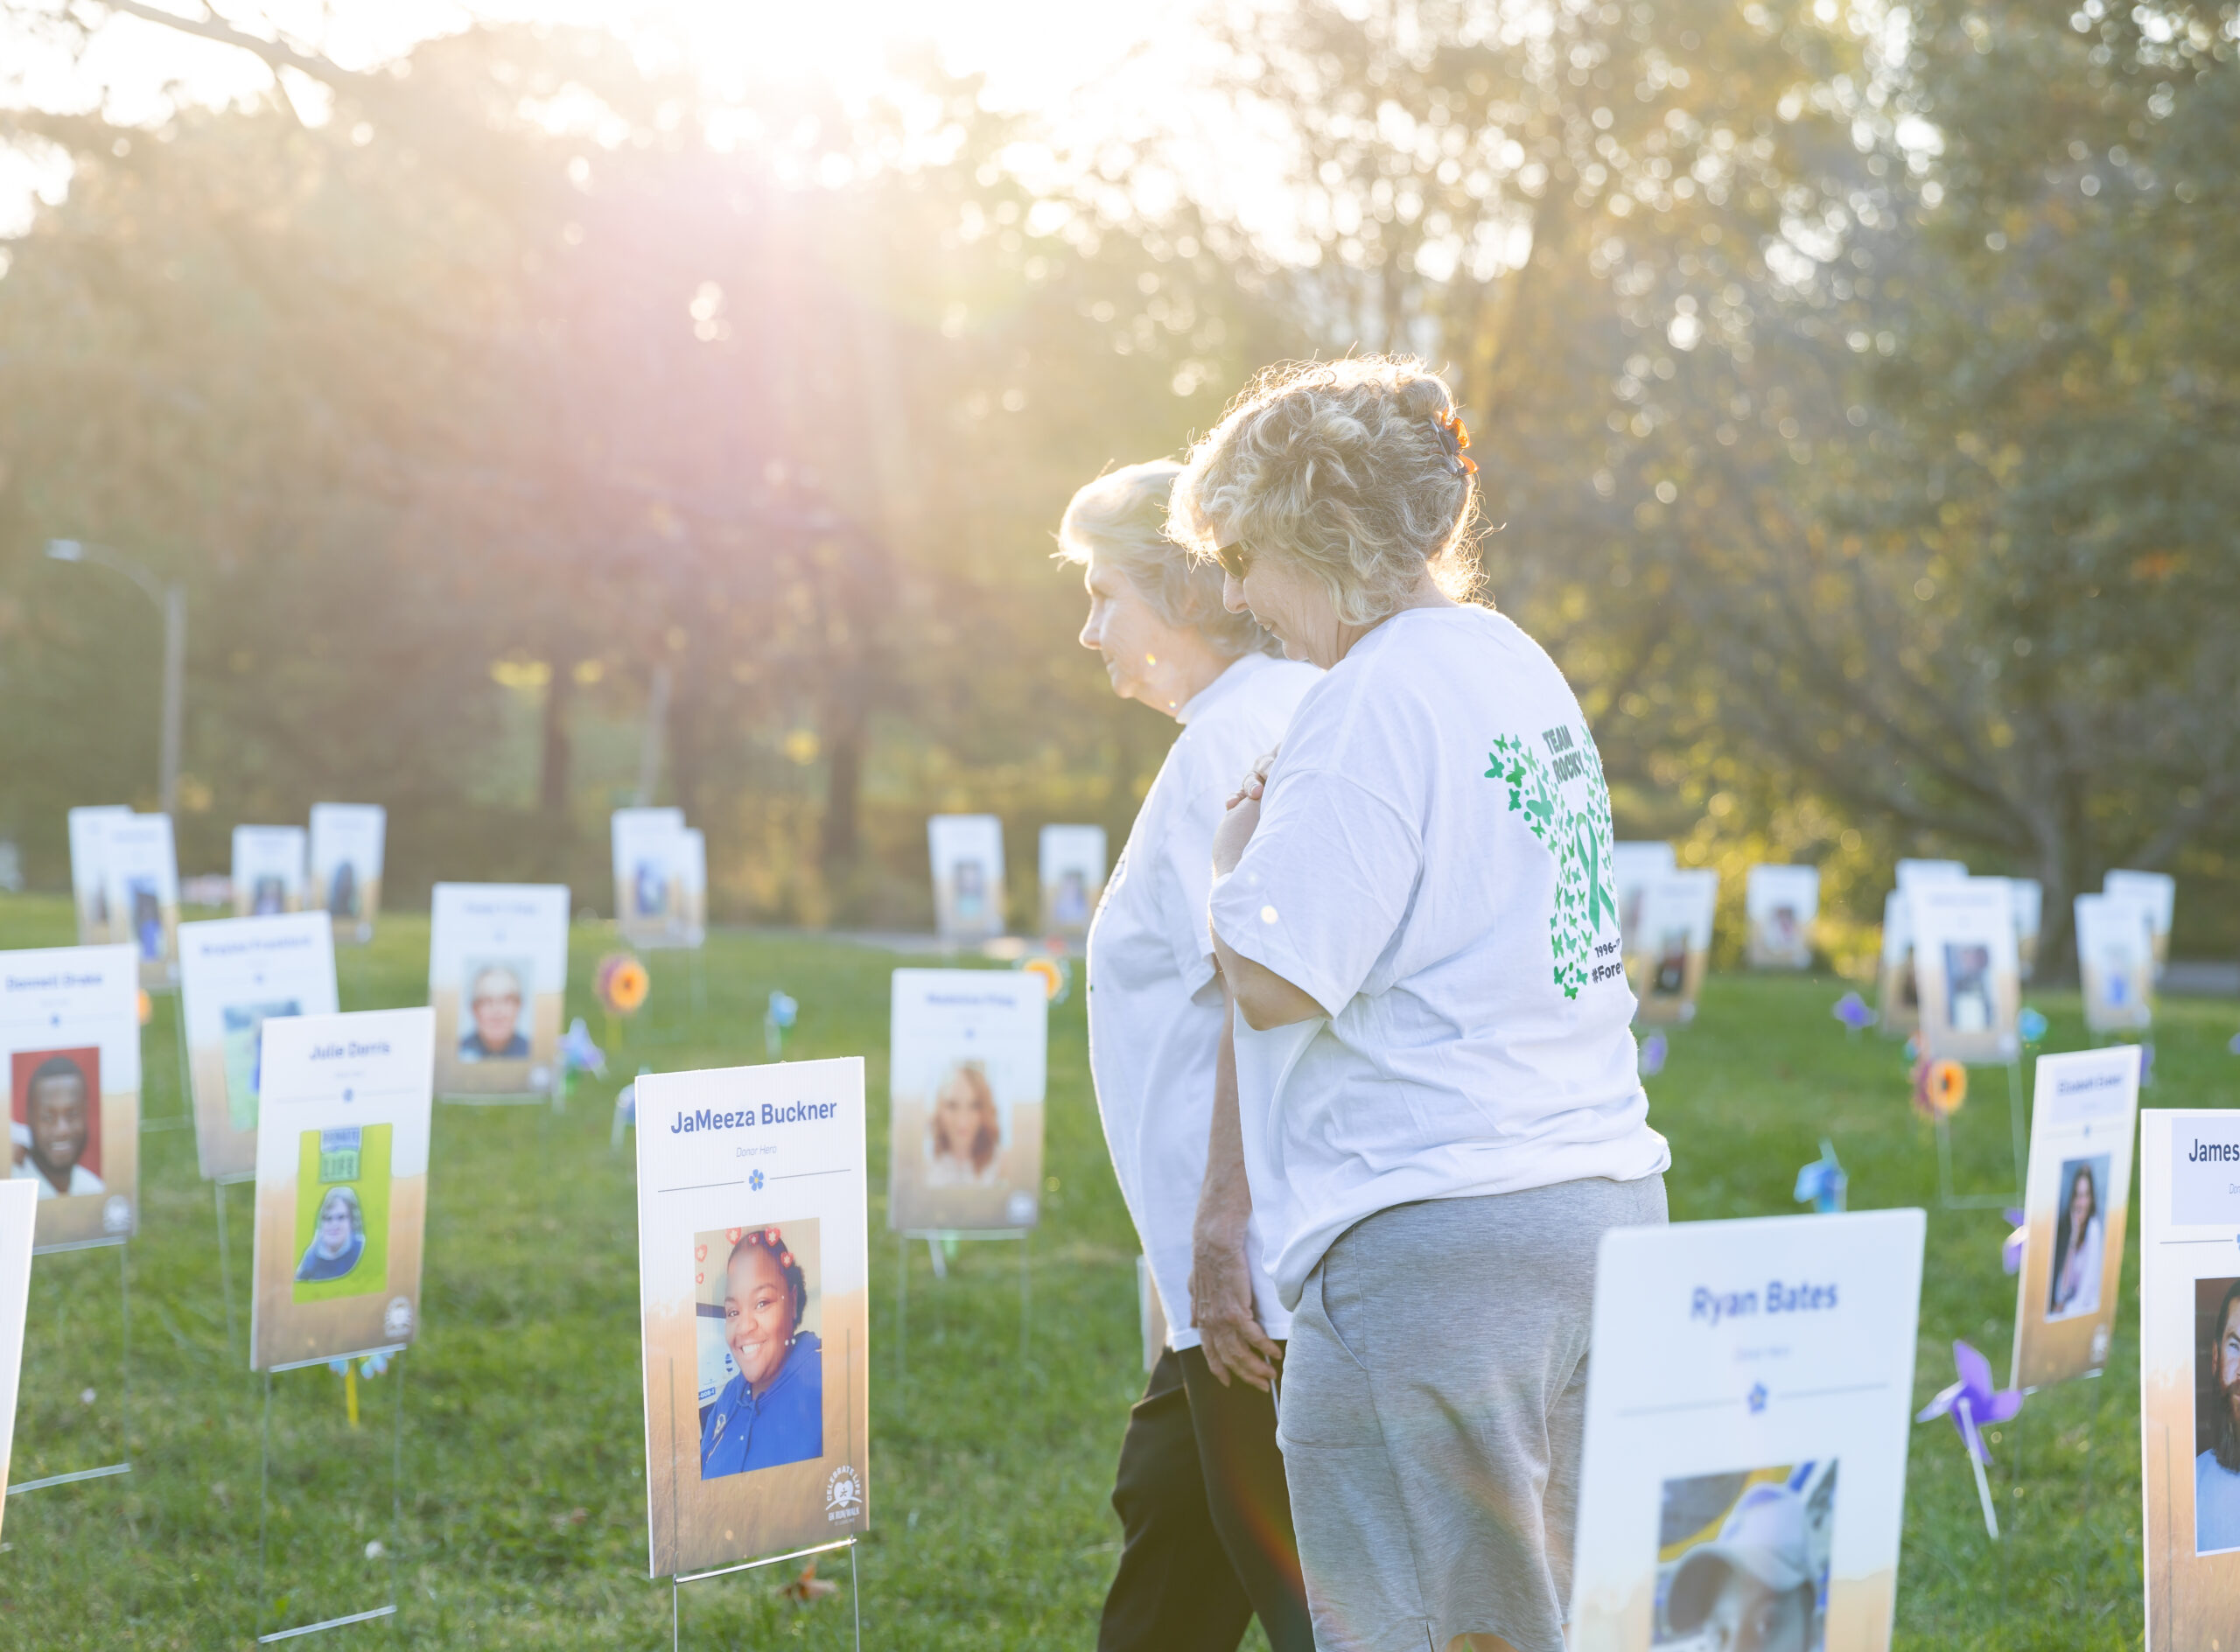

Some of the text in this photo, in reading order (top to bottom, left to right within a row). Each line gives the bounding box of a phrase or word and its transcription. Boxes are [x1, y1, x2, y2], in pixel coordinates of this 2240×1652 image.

[1542, 724, 1574, 755] TEAM
[1552, 750, 1586, 784] ROCKY
[310, 1044, 344, 1060] Julie
[670, 1100, 837, 1134] JaMeeza Buckner
[736, 1144, 778, 1158] Donor Hero
[2188, 1138, 2240, 1162] James
[1690, 1280, 1838, 1327] Ryan Bates
[826, 1465, 861, 1502] CELEBRATE LIFE
